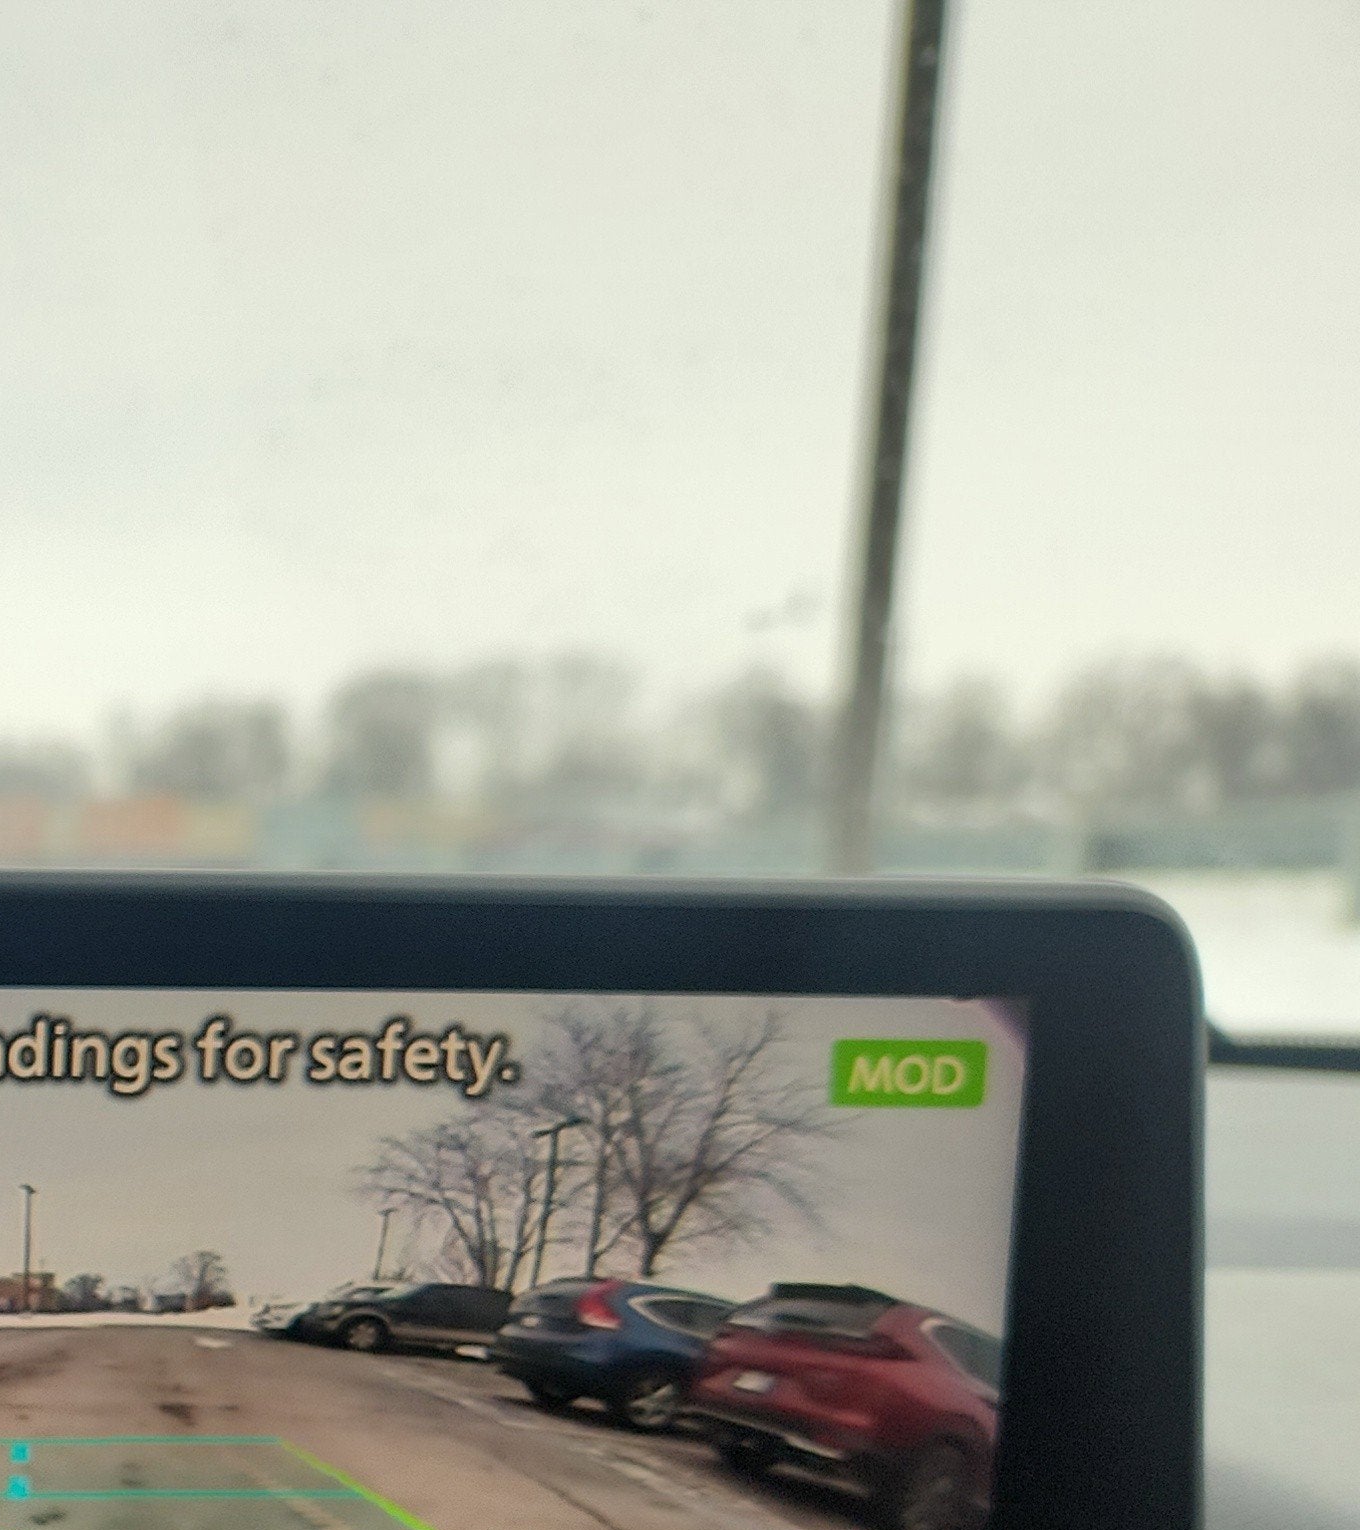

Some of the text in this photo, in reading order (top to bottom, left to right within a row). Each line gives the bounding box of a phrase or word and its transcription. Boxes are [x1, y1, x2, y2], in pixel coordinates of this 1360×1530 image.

[198, 1018, 297, 1080] for
[310, 1022, 523, 1096] safety.
[847, 1054, 966, 1096] MOD
